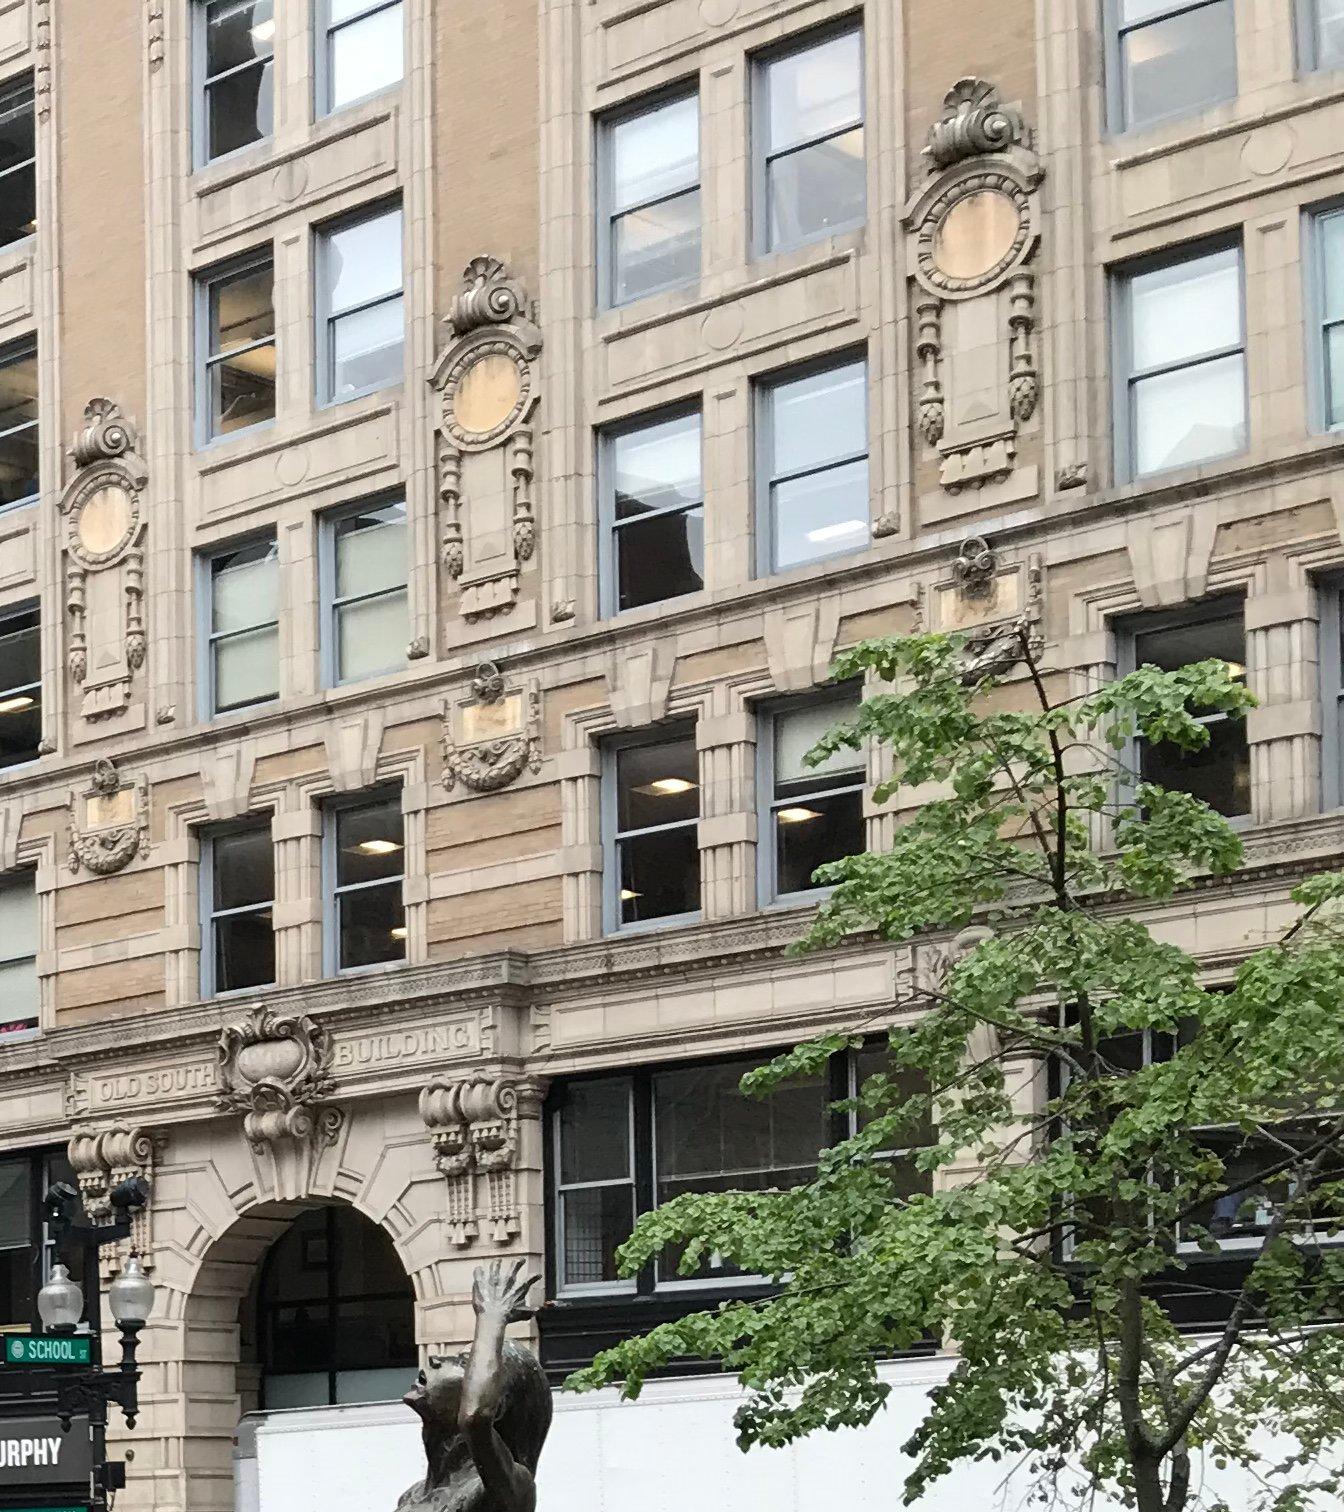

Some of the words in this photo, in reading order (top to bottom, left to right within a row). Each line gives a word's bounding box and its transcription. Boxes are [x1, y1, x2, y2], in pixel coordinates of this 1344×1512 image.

[100, 1079, 142, 1101] OLD
[146, 1064, 217, 1094] SOUTH
[334, 1025, 472, 1068] BUILDING
[28, 1340, 75, 1359] SCHOOL
[79, 1349, 87, 1359] ST
